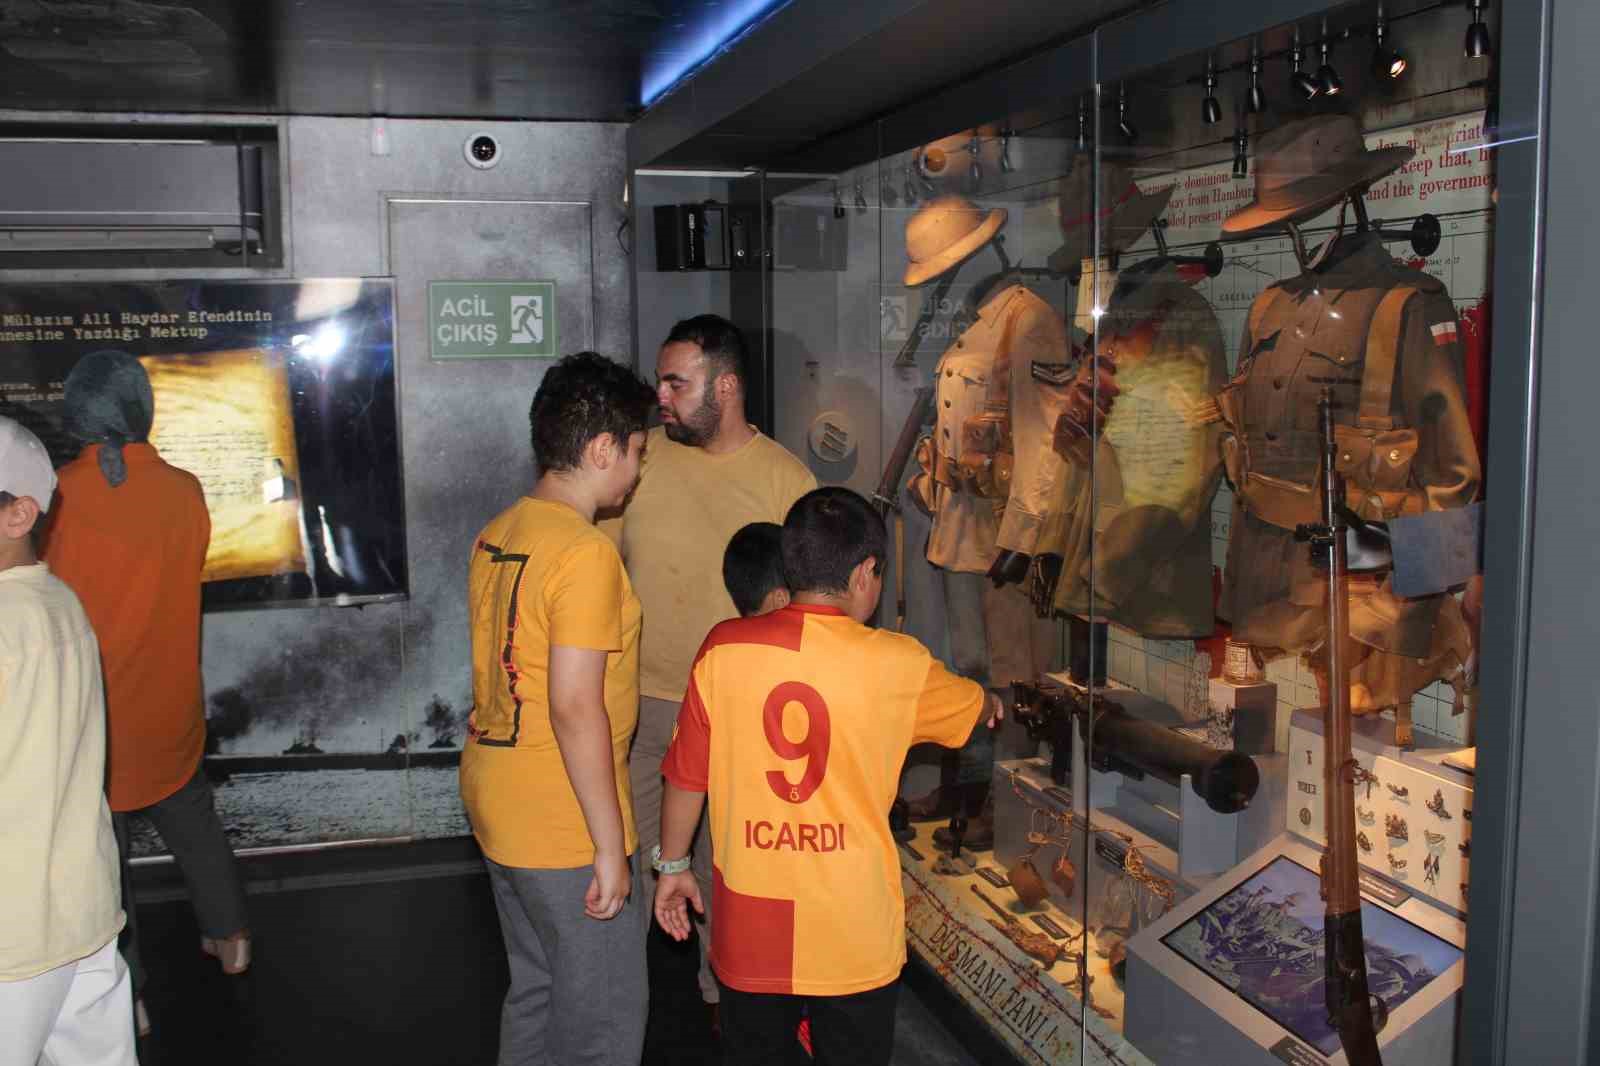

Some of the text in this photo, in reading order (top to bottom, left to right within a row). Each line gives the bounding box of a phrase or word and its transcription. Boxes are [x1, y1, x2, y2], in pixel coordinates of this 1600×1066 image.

[1399, 158, 1433, 176] keep
[1439, 148, 1473, 169] that,
[1365, 180, 1390, 201] and
[1391, 178, 1415, 198] the
[440, 293, 495, 317] ACİL
[82, 312, 111, 325] Ali
[120, 311, 178, 326] Haydar
[188, 310, 272, 323] Efendinin
[150, 326, 208, 339] Mektup
[438, 323, 498, 346] ÇIKIŞ
[762, 681, 831, 804] 9
[744, 819, 846, 852] ICARDI
